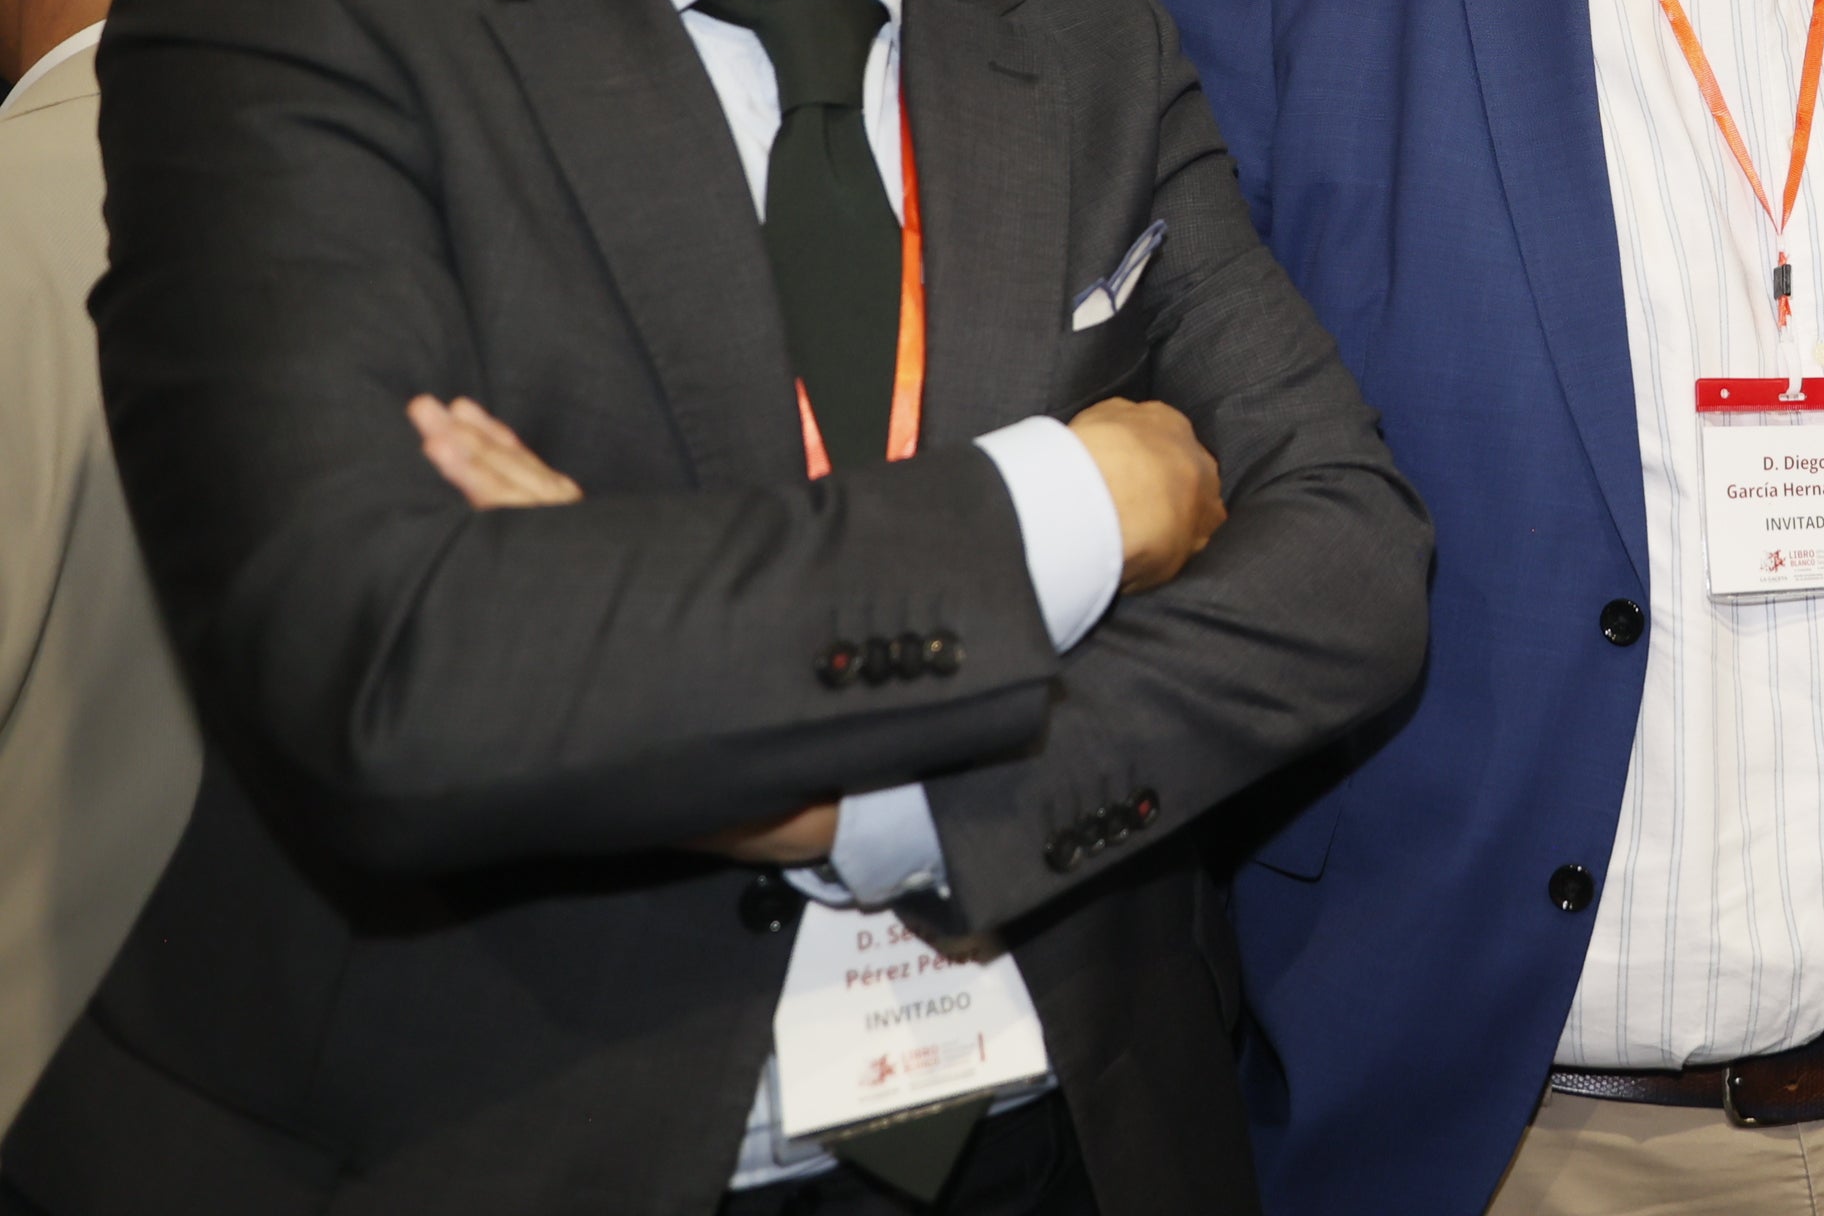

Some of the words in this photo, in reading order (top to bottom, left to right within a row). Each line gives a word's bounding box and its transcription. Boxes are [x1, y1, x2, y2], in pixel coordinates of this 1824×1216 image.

[1763, 456, 1779, 471] D.
[1727, 482, 1778, 499] García
[1789, 549, 1815, 559] LIBRO
[857, 930, 880, 951] D.
[845, 963, 911, 989] Pérez
[865, 991, 971, 1030] INVITADO
